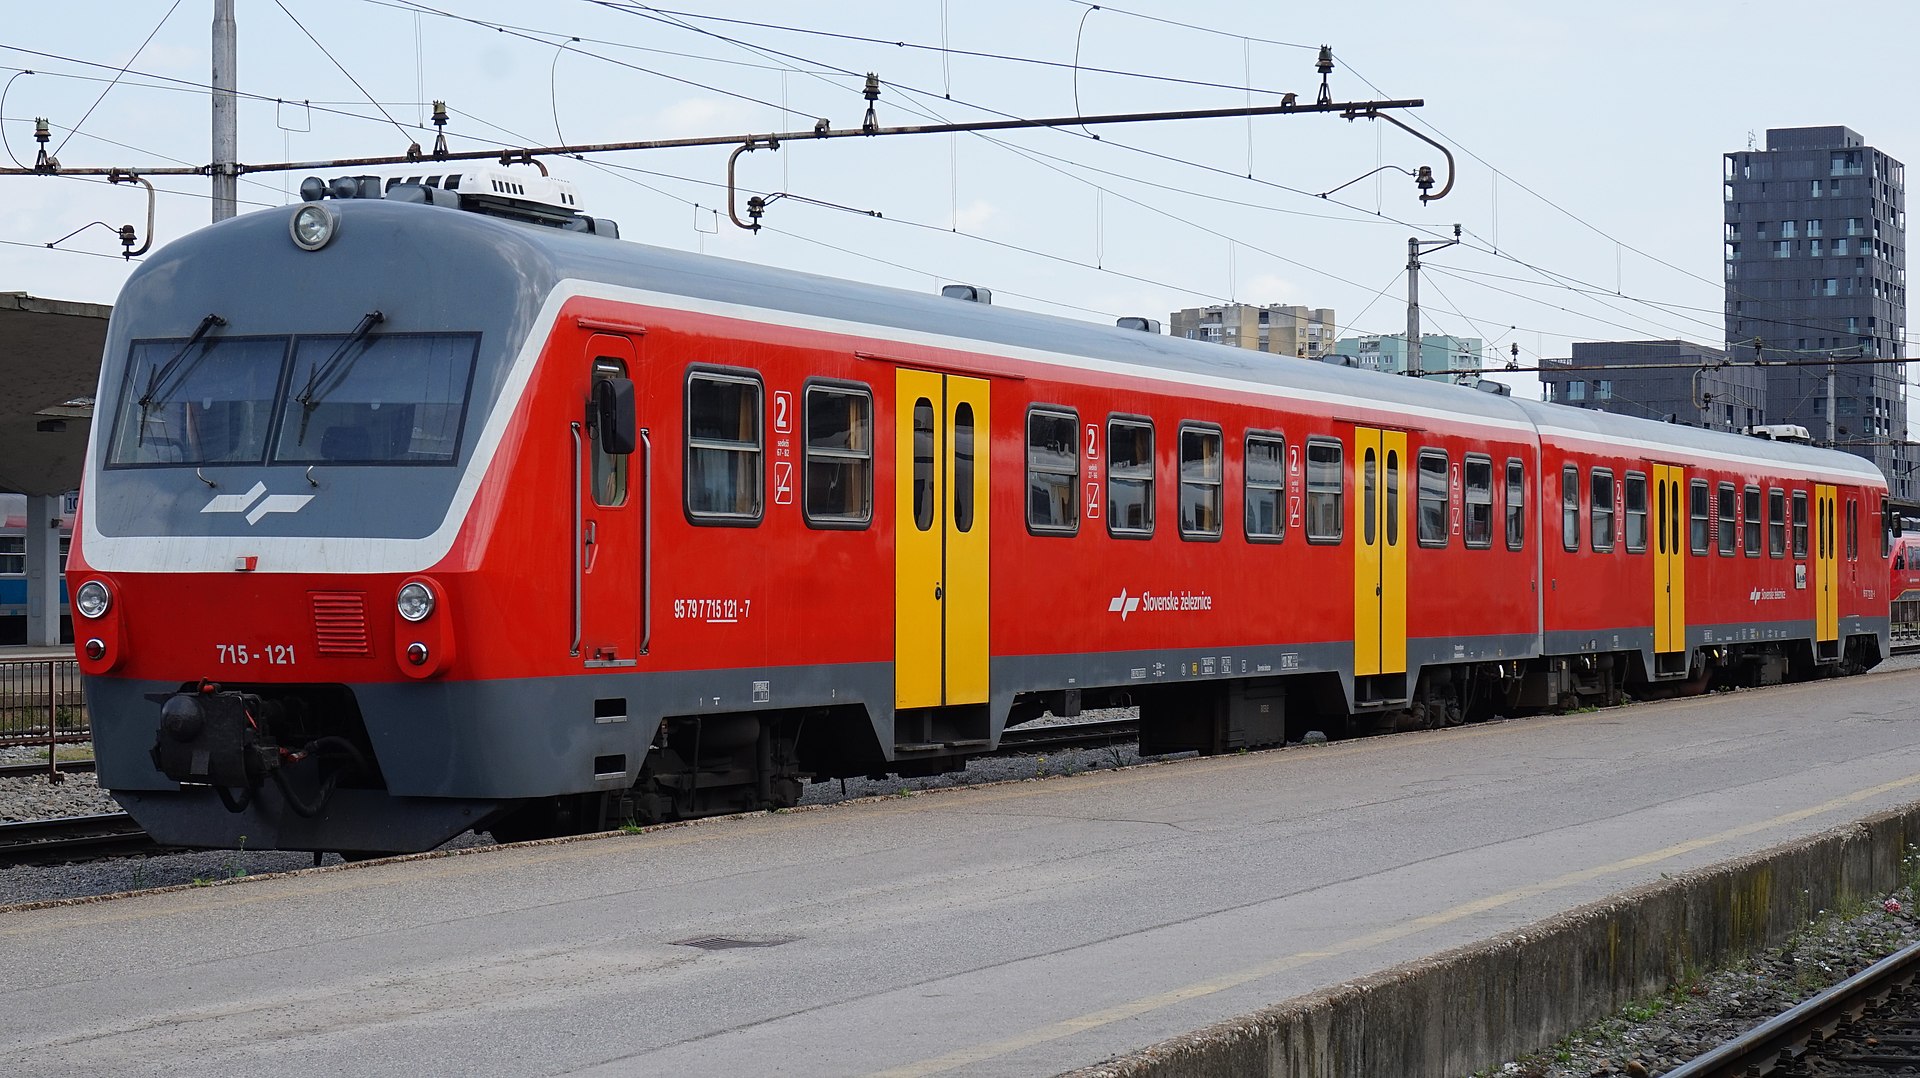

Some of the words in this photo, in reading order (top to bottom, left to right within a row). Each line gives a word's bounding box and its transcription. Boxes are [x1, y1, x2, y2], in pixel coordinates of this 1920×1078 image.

[777, 396, 787, 428] 2
[1088, 428, 1096, 455] 2
[1291, 449, 1298, 472] 2
[1453, 466, 1458, 486] 2
[674, 599, 685, 618] 95
[687, 599, 697, 618] 79
[699, 599, 704, 618] 7
[706, 599, 721, 618] 715
[724, 599, 737, 618] 121
[745, 599, 750, 618] 7
[1143, 591, 1179, 611] Slovenske
[1180, 591, 1212, 611] železnice
[216, 644, 249, 664] 715
[265, 644, 295, 664] 121
